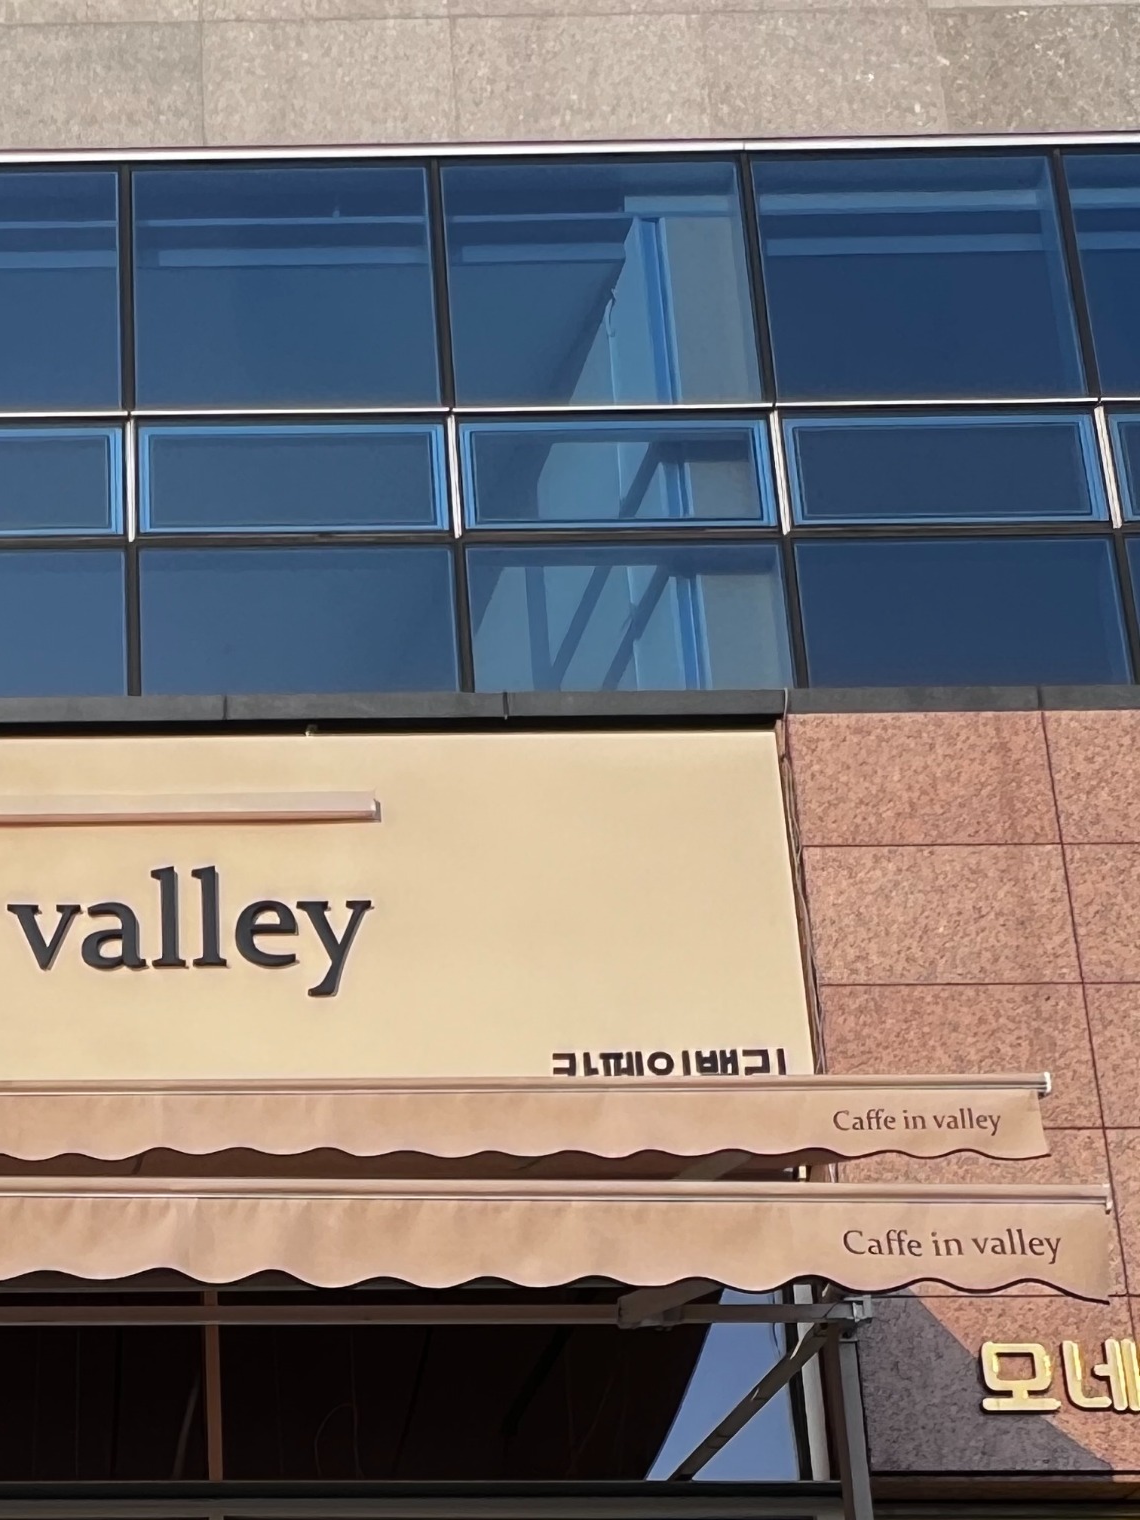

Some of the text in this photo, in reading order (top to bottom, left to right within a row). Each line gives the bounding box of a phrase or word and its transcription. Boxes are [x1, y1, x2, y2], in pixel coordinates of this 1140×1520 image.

[6, 865, 374, 997] valley
[832, 1107, 1002, 1137] Caffe in valley
[841, 1227, 1062, 1265] Caffe in valley
